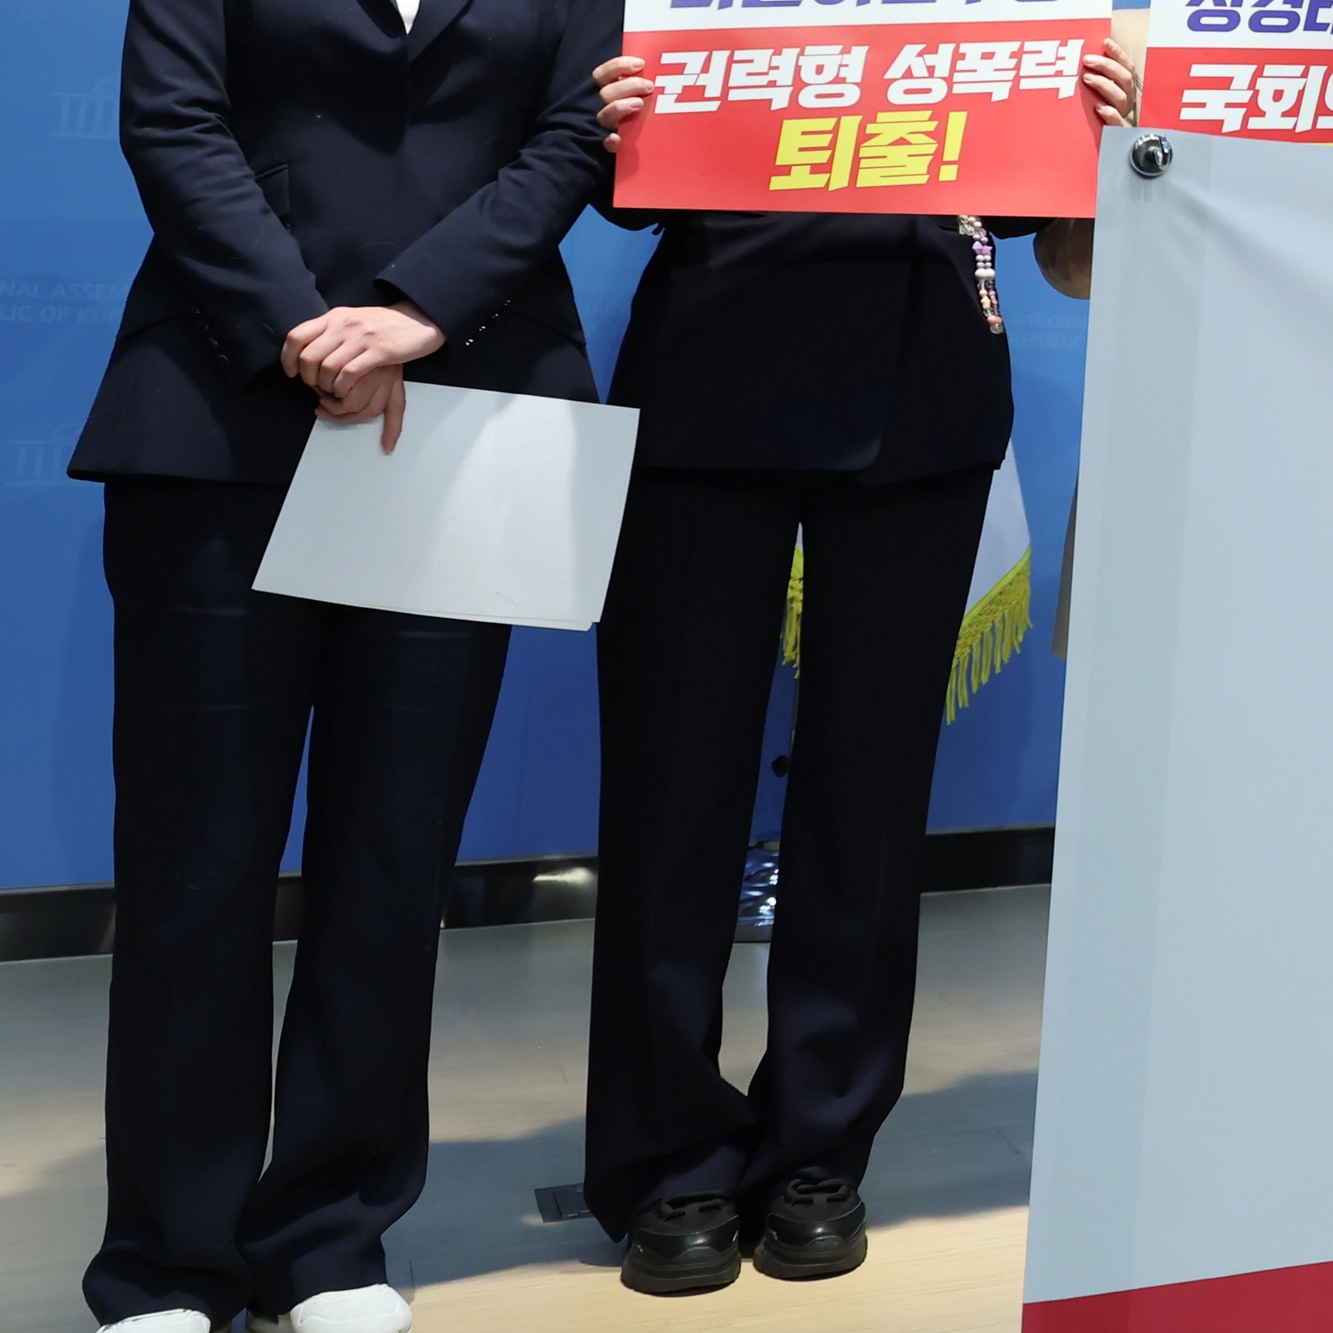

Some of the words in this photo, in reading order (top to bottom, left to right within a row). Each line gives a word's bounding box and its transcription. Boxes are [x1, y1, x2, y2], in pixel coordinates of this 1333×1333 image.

[653, 44, 869, 115] 권력형
[883, 38, 1085, 106] 성폭력
[768, 110, 968, 192] 퇴출!
